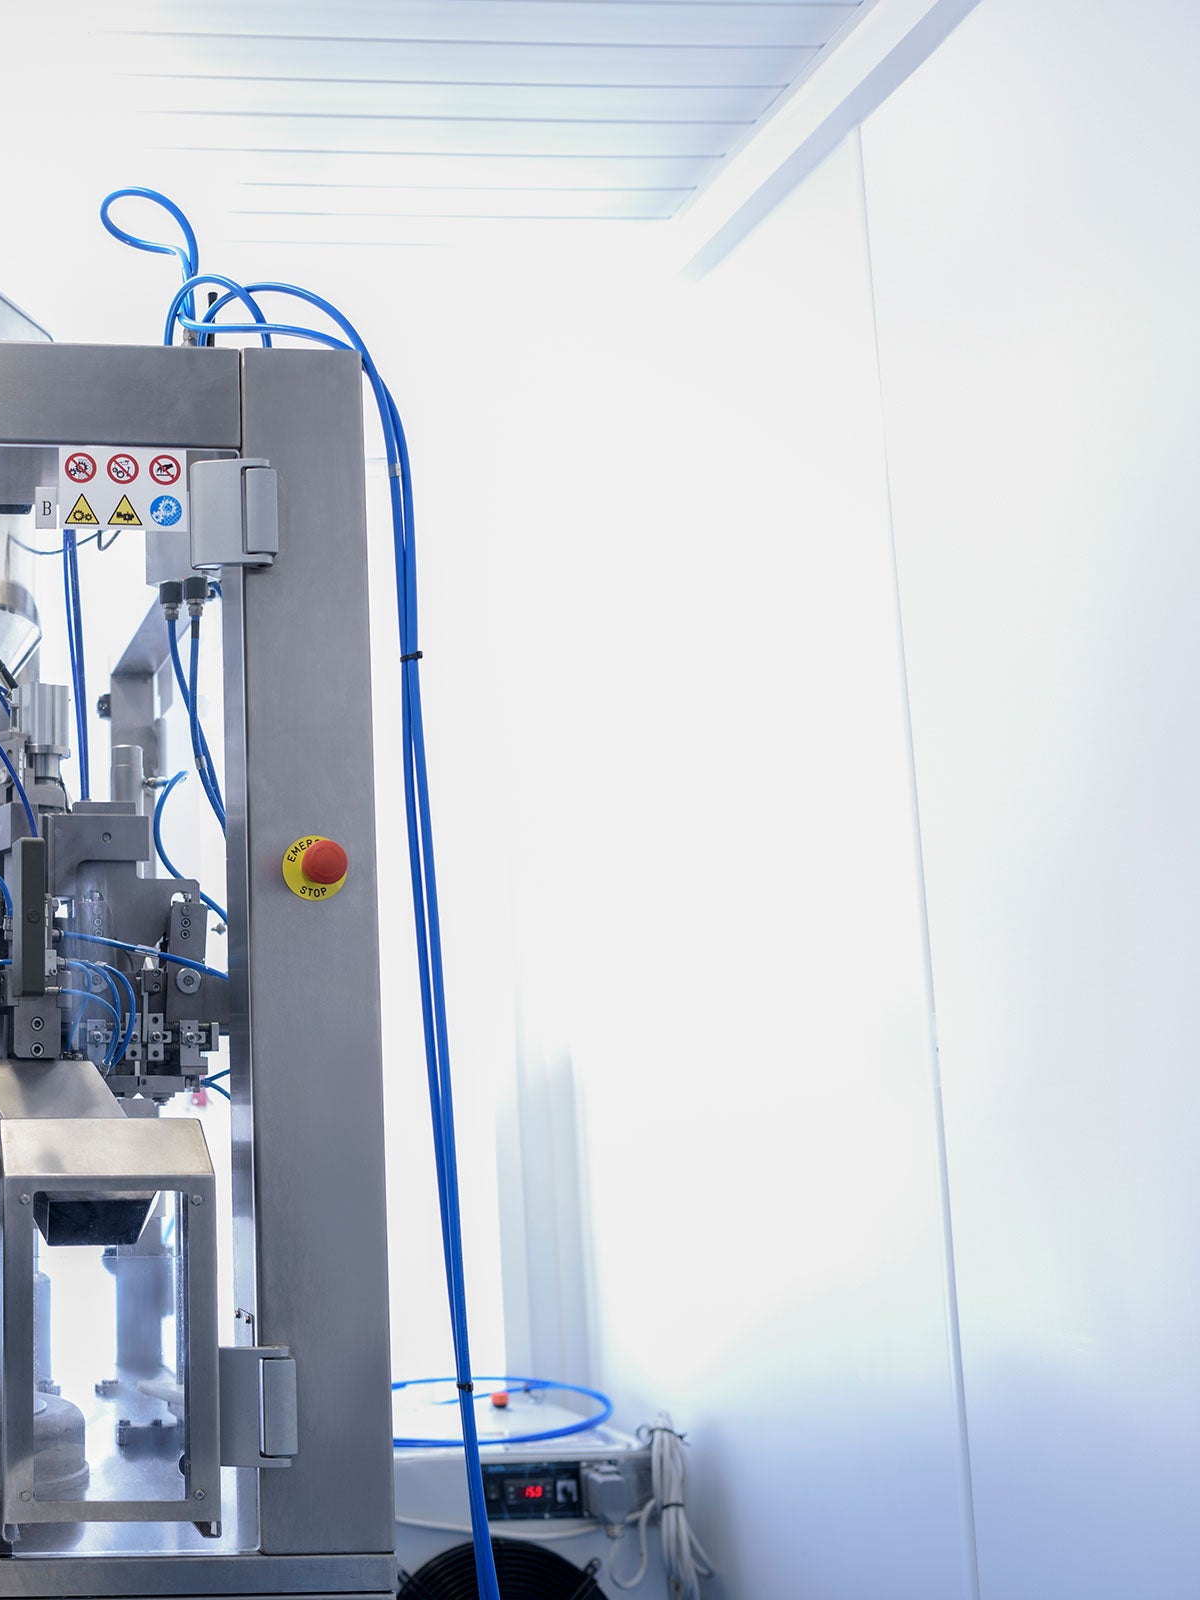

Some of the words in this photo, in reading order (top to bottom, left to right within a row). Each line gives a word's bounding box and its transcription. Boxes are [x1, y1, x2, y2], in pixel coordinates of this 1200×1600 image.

[42, 501, 52, 516] B
[287, 838, 320, 863] EMER
[299, 885, 327, 898] STOP
